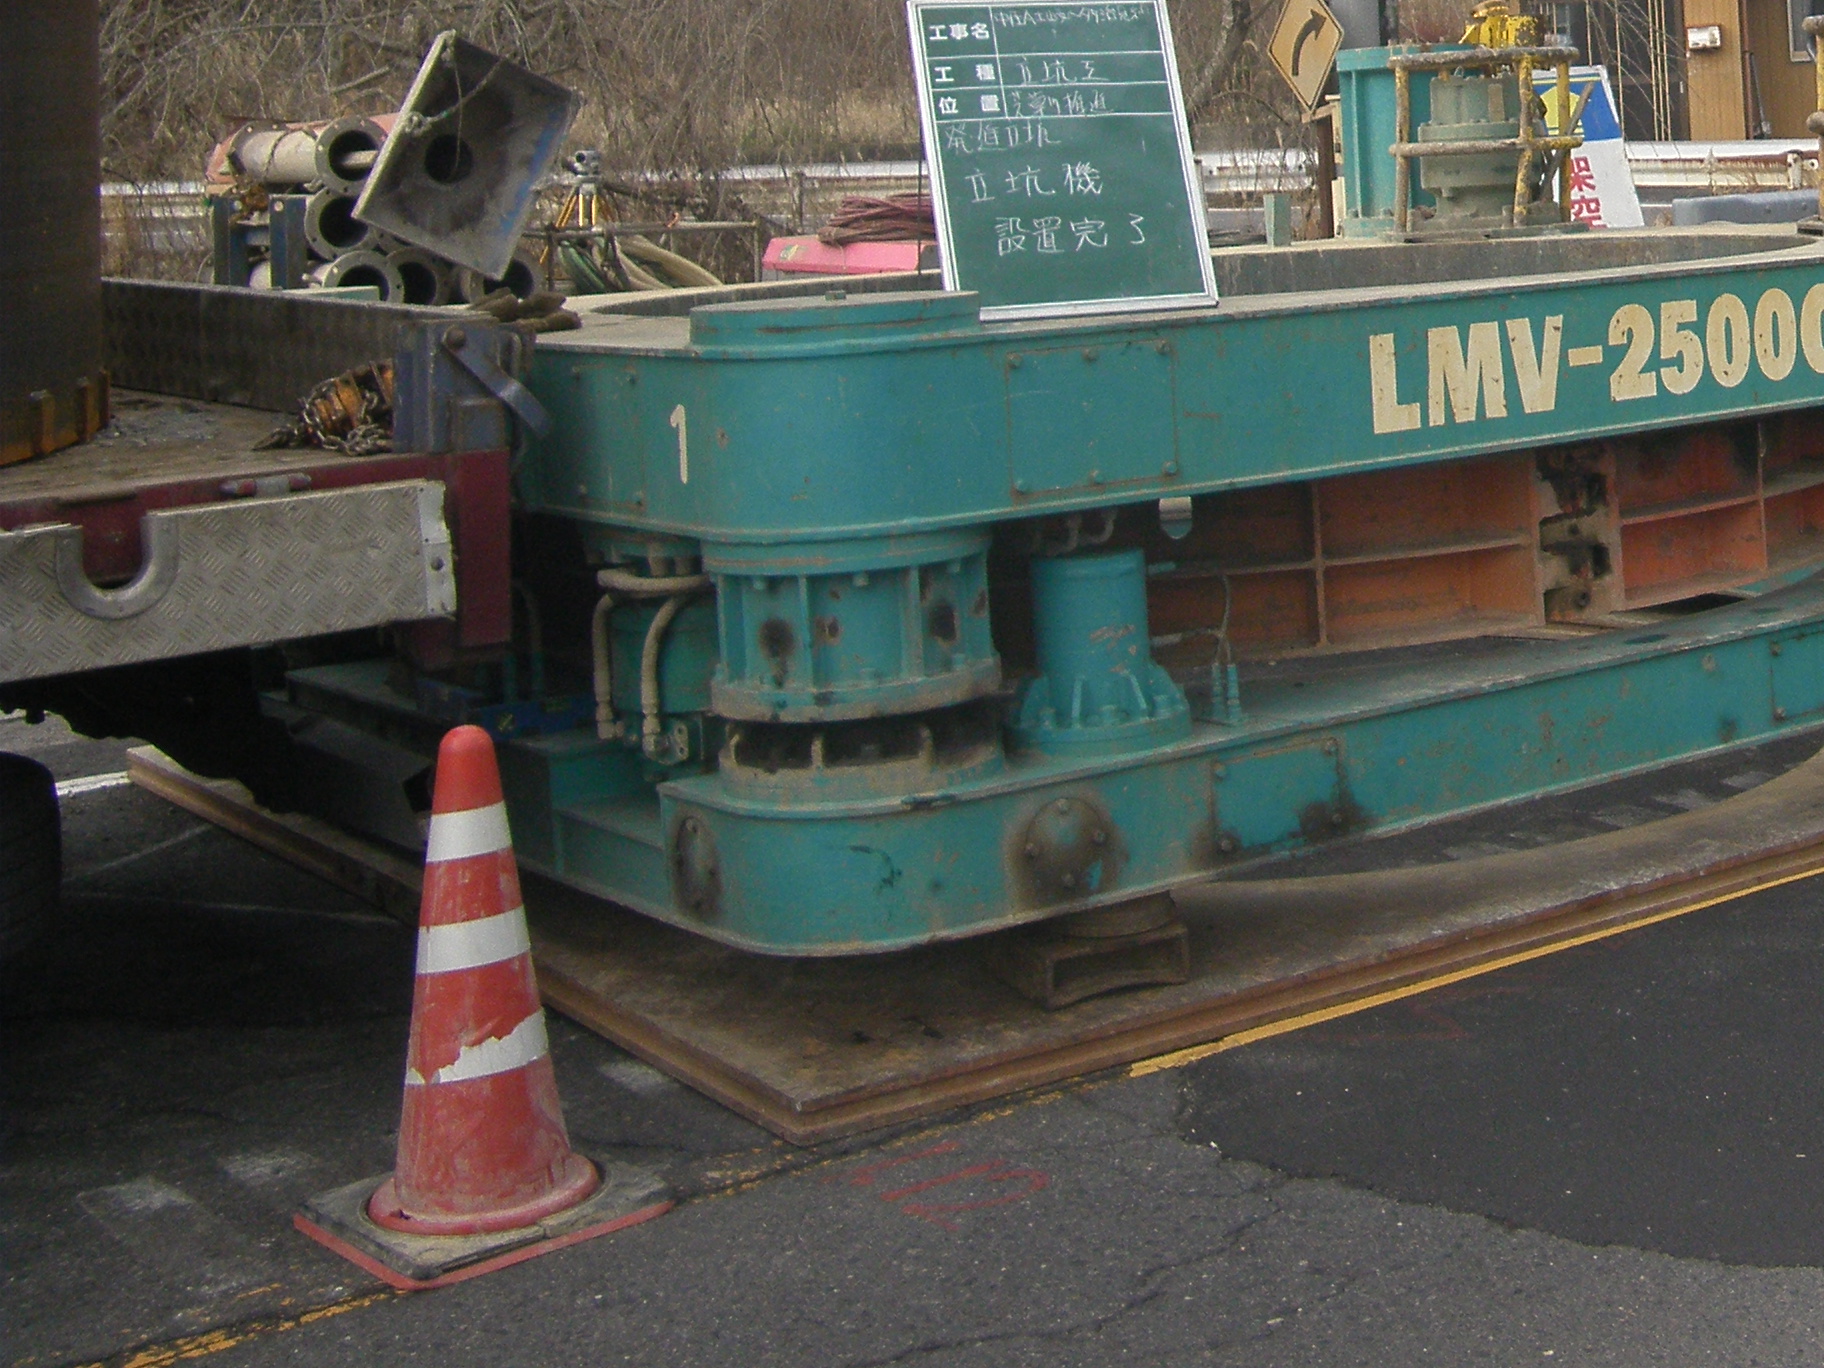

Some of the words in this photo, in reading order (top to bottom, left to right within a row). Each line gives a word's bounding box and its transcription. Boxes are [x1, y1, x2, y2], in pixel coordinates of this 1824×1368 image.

[928, 22, 990, 41] 工事名
[669, 403, 689, 485] 1
